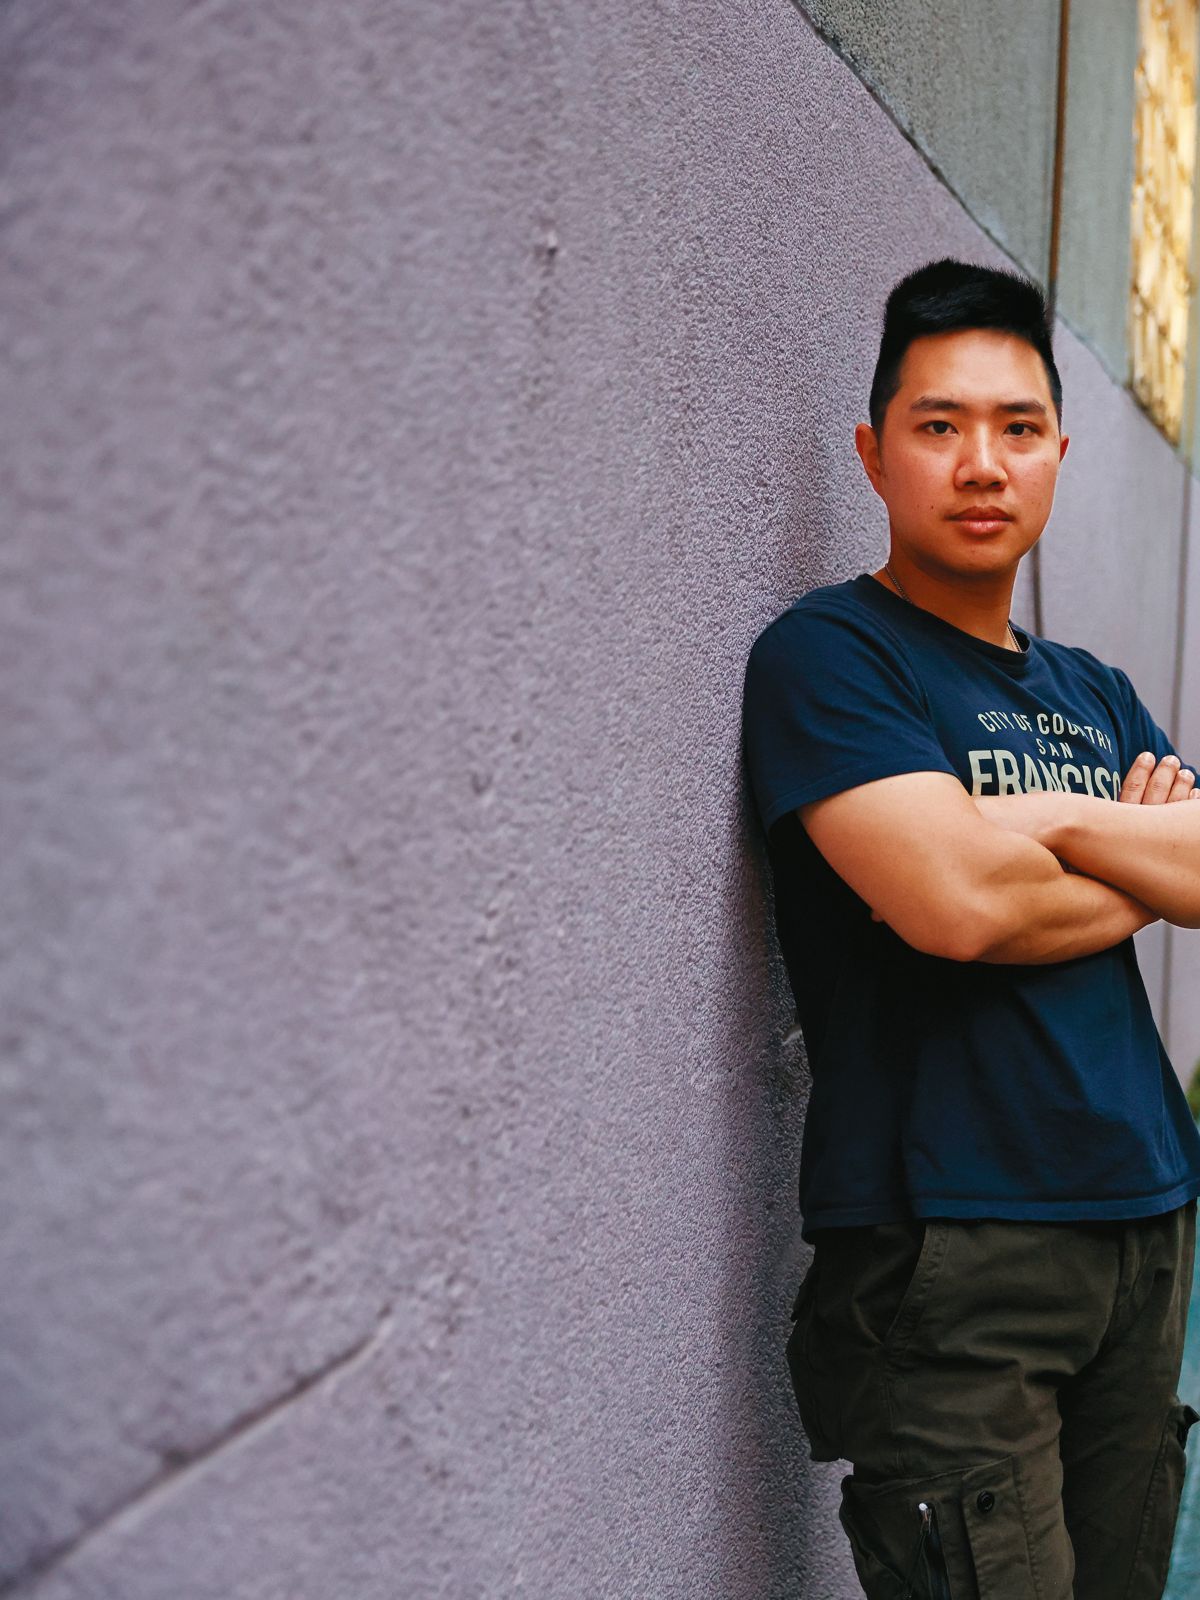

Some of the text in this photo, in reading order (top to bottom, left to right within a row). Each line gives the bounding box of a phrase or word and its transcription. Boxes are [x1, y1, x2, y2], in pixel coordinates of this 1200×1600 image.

[977, 711, 1015, 733] CITY
[1012, 712, 1033, 732] OF
[1035, 738, 1074, 759] SAN
